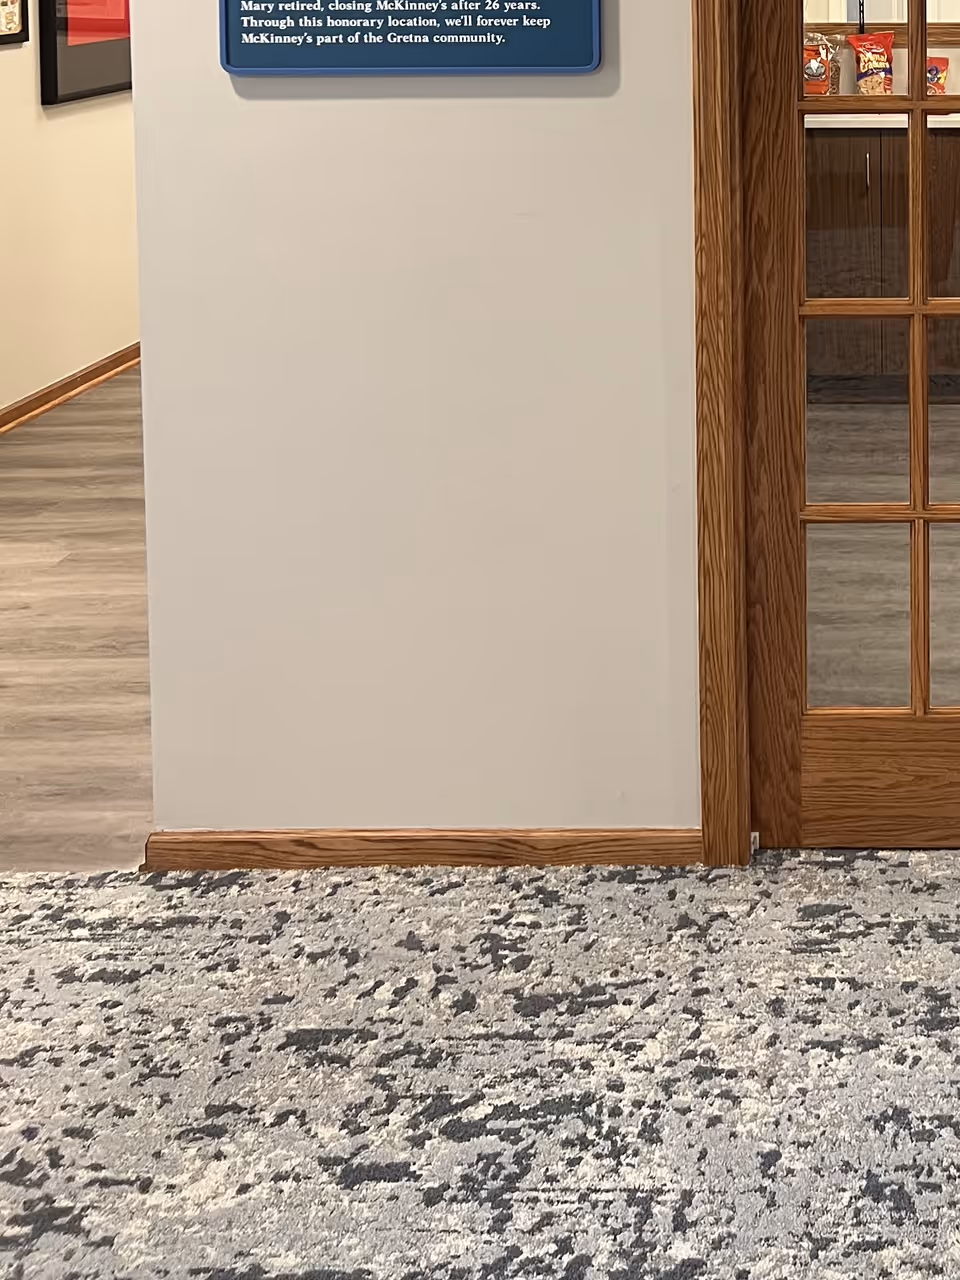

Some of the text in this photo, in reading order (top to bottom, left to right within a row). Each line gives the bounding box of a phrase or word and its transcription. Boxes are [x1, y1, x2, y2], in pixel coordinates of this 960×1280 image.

[240, 0, 275, 14] Mary
[278, 0, 325, 12] retired,
[327, 0, 373, 14] closing
[484, 0, 500, 11] 26
[503, 1, 541, 13] years.
[240, 14, 551, 30] Through this honorary location, we'll forever keep
[241, 31, 506, 46] McKinney's part of the Gretna community.
[859, 52, 887, 63] Animal
[860, 62, 890, 73] Crackers
